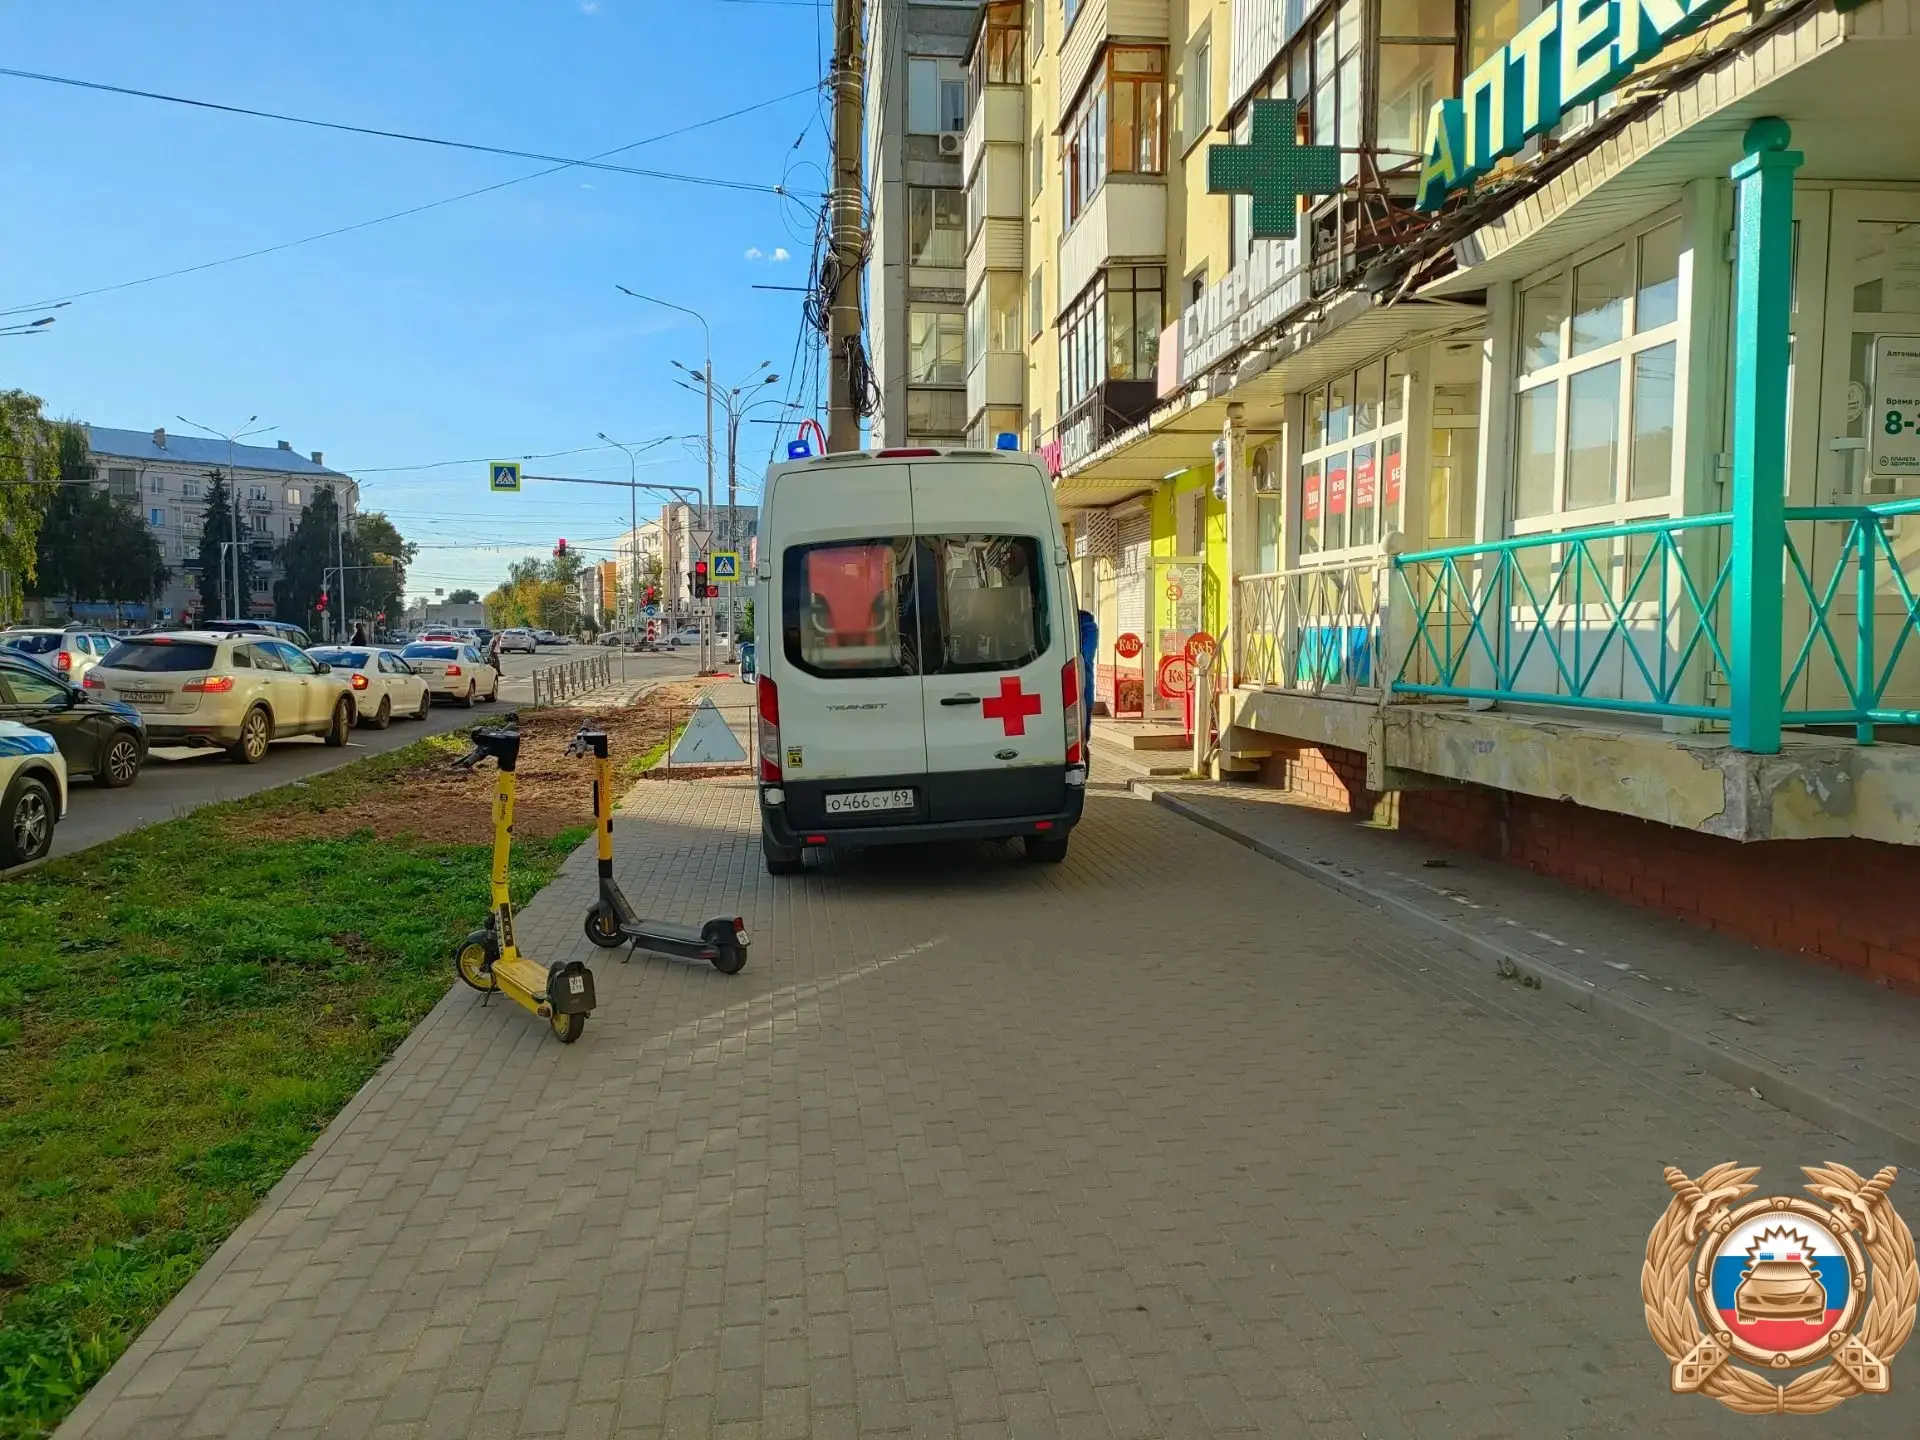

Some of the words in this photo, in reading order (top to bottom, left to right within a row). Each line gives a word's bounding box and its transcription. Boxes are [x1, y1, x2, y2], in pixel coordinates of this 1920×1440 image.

[1240, 273, 1301, 341] СТРИЖКИ
[1886, 398, 1913, 406] Время
[1119, 639, 1139, 652] К&Б
[1189, 640, 1213, 656] К&Б
[826, 703, 888, 712] TRANSIT
[893, 790, 909, 802] 69
